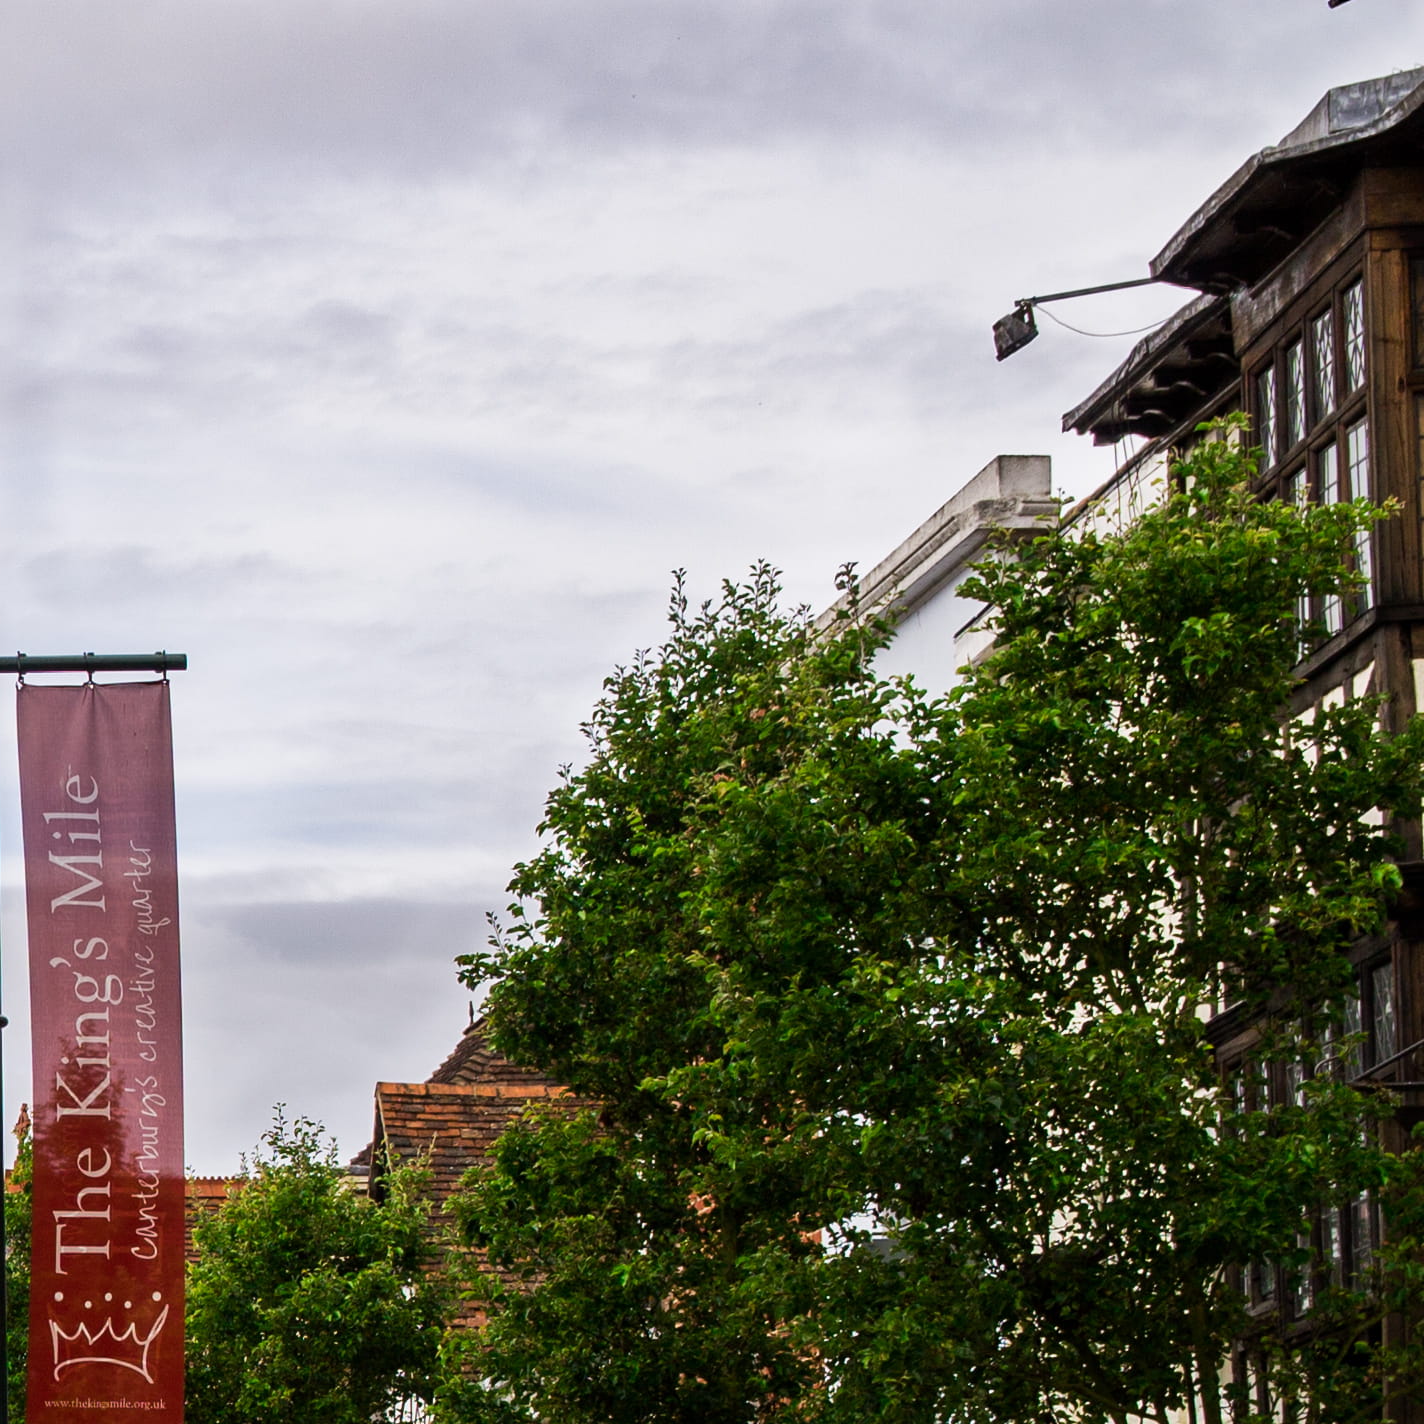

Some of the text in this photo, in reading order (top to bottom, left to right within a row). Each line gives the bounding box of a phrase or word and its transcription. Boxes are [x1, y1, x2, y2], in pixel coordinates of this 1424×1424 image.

[123, 840, 171, 936] quarter
[43, 774, 124, 1276] The King's Mile
[128, 946, 157, 1062] creative
